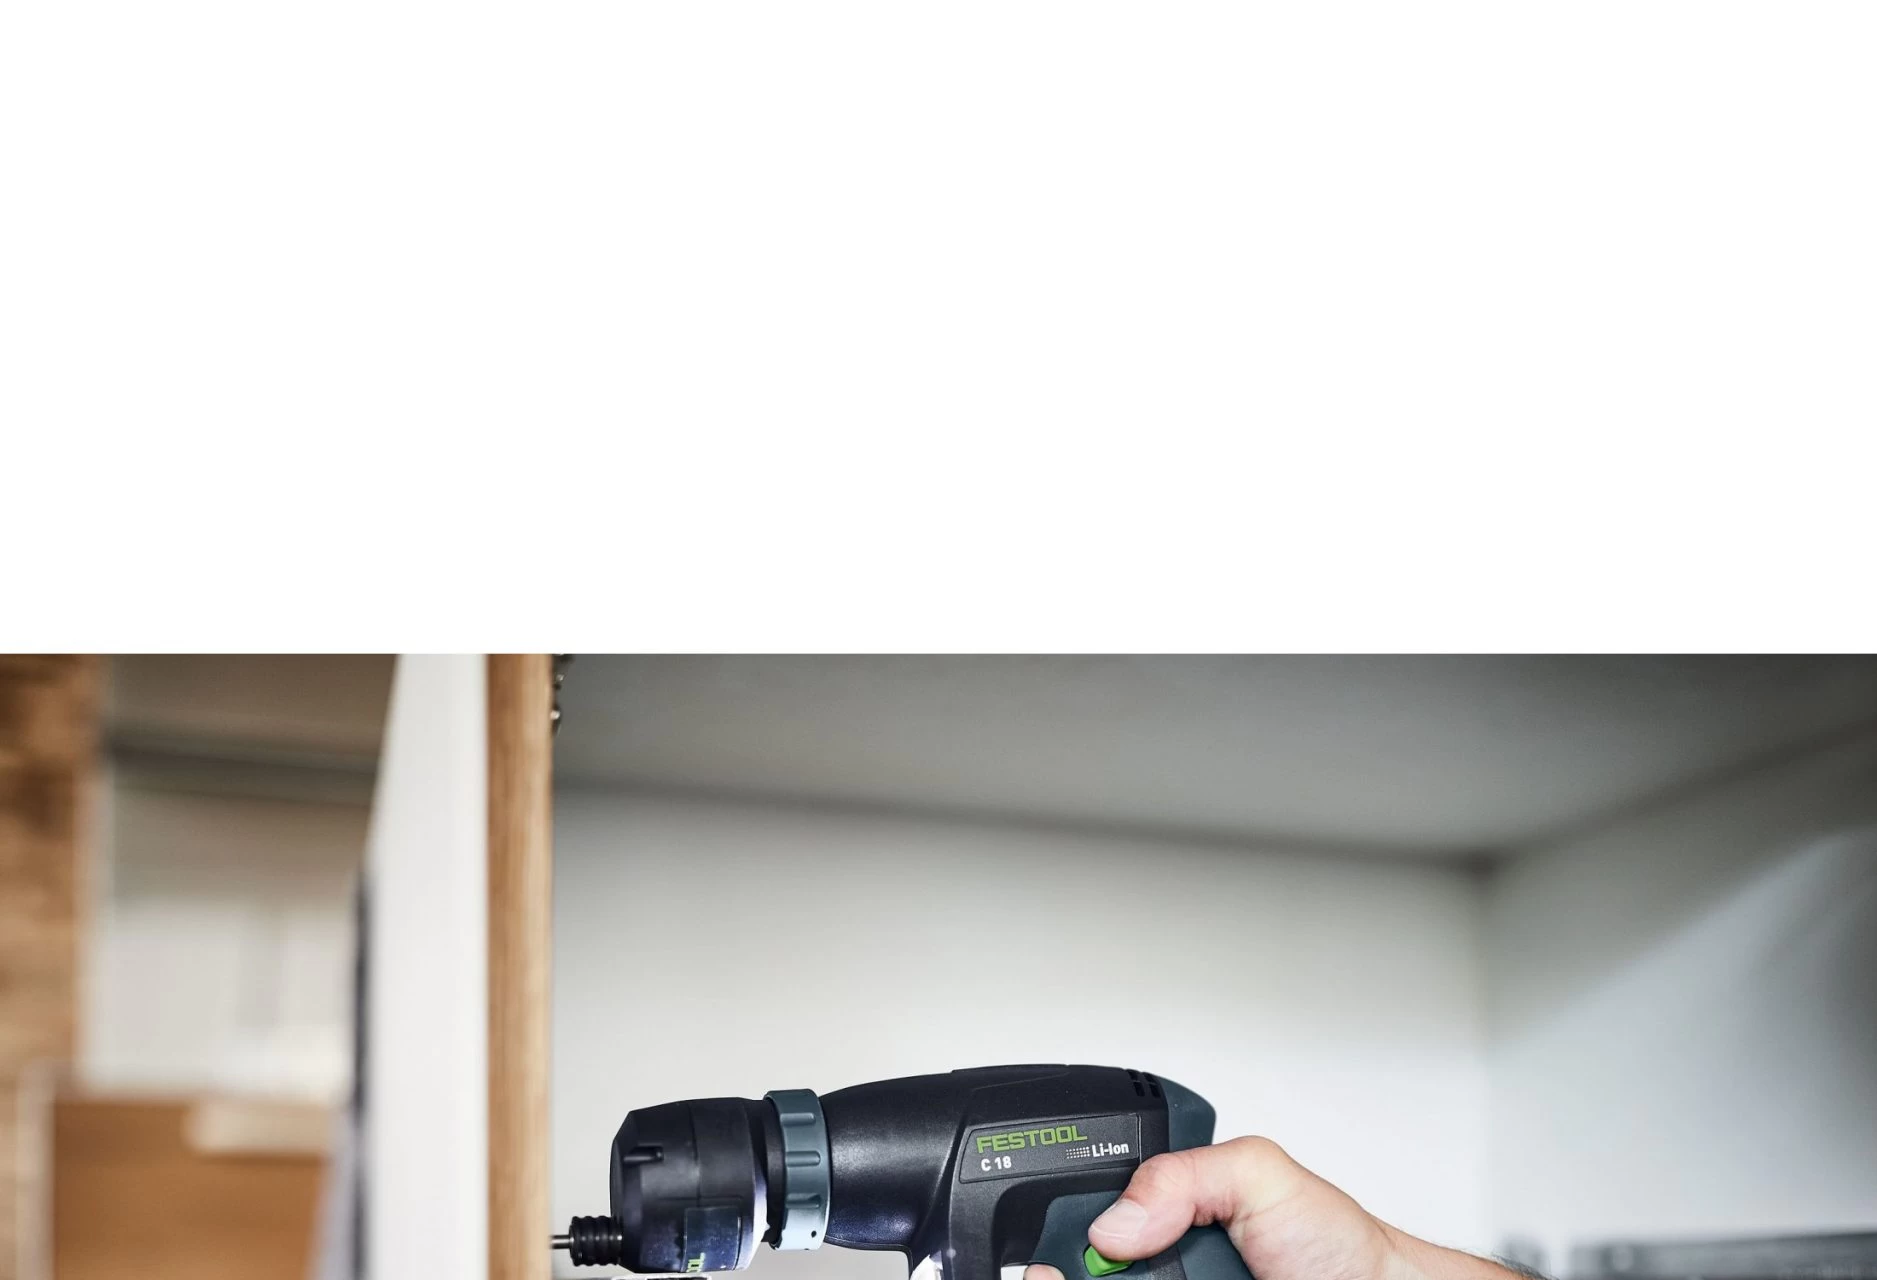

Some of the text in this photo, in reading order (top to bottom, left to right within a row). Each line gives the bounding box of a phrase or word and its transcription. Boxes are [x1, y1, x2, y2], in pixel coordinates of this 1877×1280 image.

[976, 1124, 1088, 1154] FESTOOL
[1092, 1142, 1130, 1158] Li-Ion
[980, 1155, 1013, 1172] C 18
